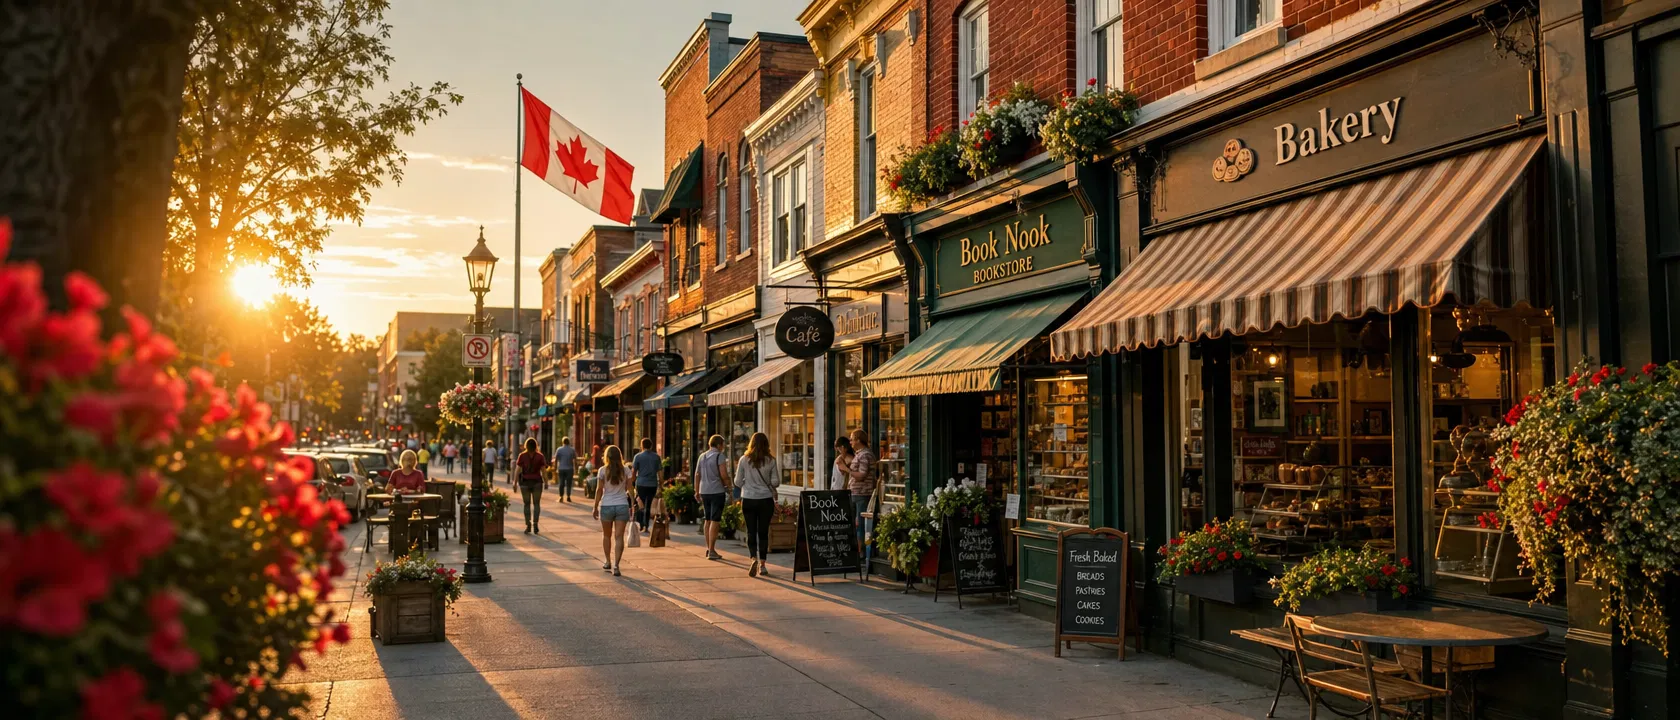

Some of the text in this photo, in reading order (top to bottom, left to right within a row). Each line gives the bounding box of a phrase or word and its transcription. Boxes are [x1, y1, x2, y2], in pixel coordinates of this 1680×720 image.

[1273, 96, 1402, 166] Bakery
[960, 213, 1051, 267] Book Nook
[973, 255, 1033, 284] BOOKSTORE
[785, 325, 821, 347] Café
[808, 495, 839, 509] Book
[820, 508, 848, 522] Nook
[1069, 550, 1118, 562] Fresh Baked
[1076, 571, 1105, 581] BREADS
[1075, 586, 1106, 596] PASTRIES
[1076, 600, 1101, 610] CAKES
[1075, 615, 1105, 625] COOKIES
